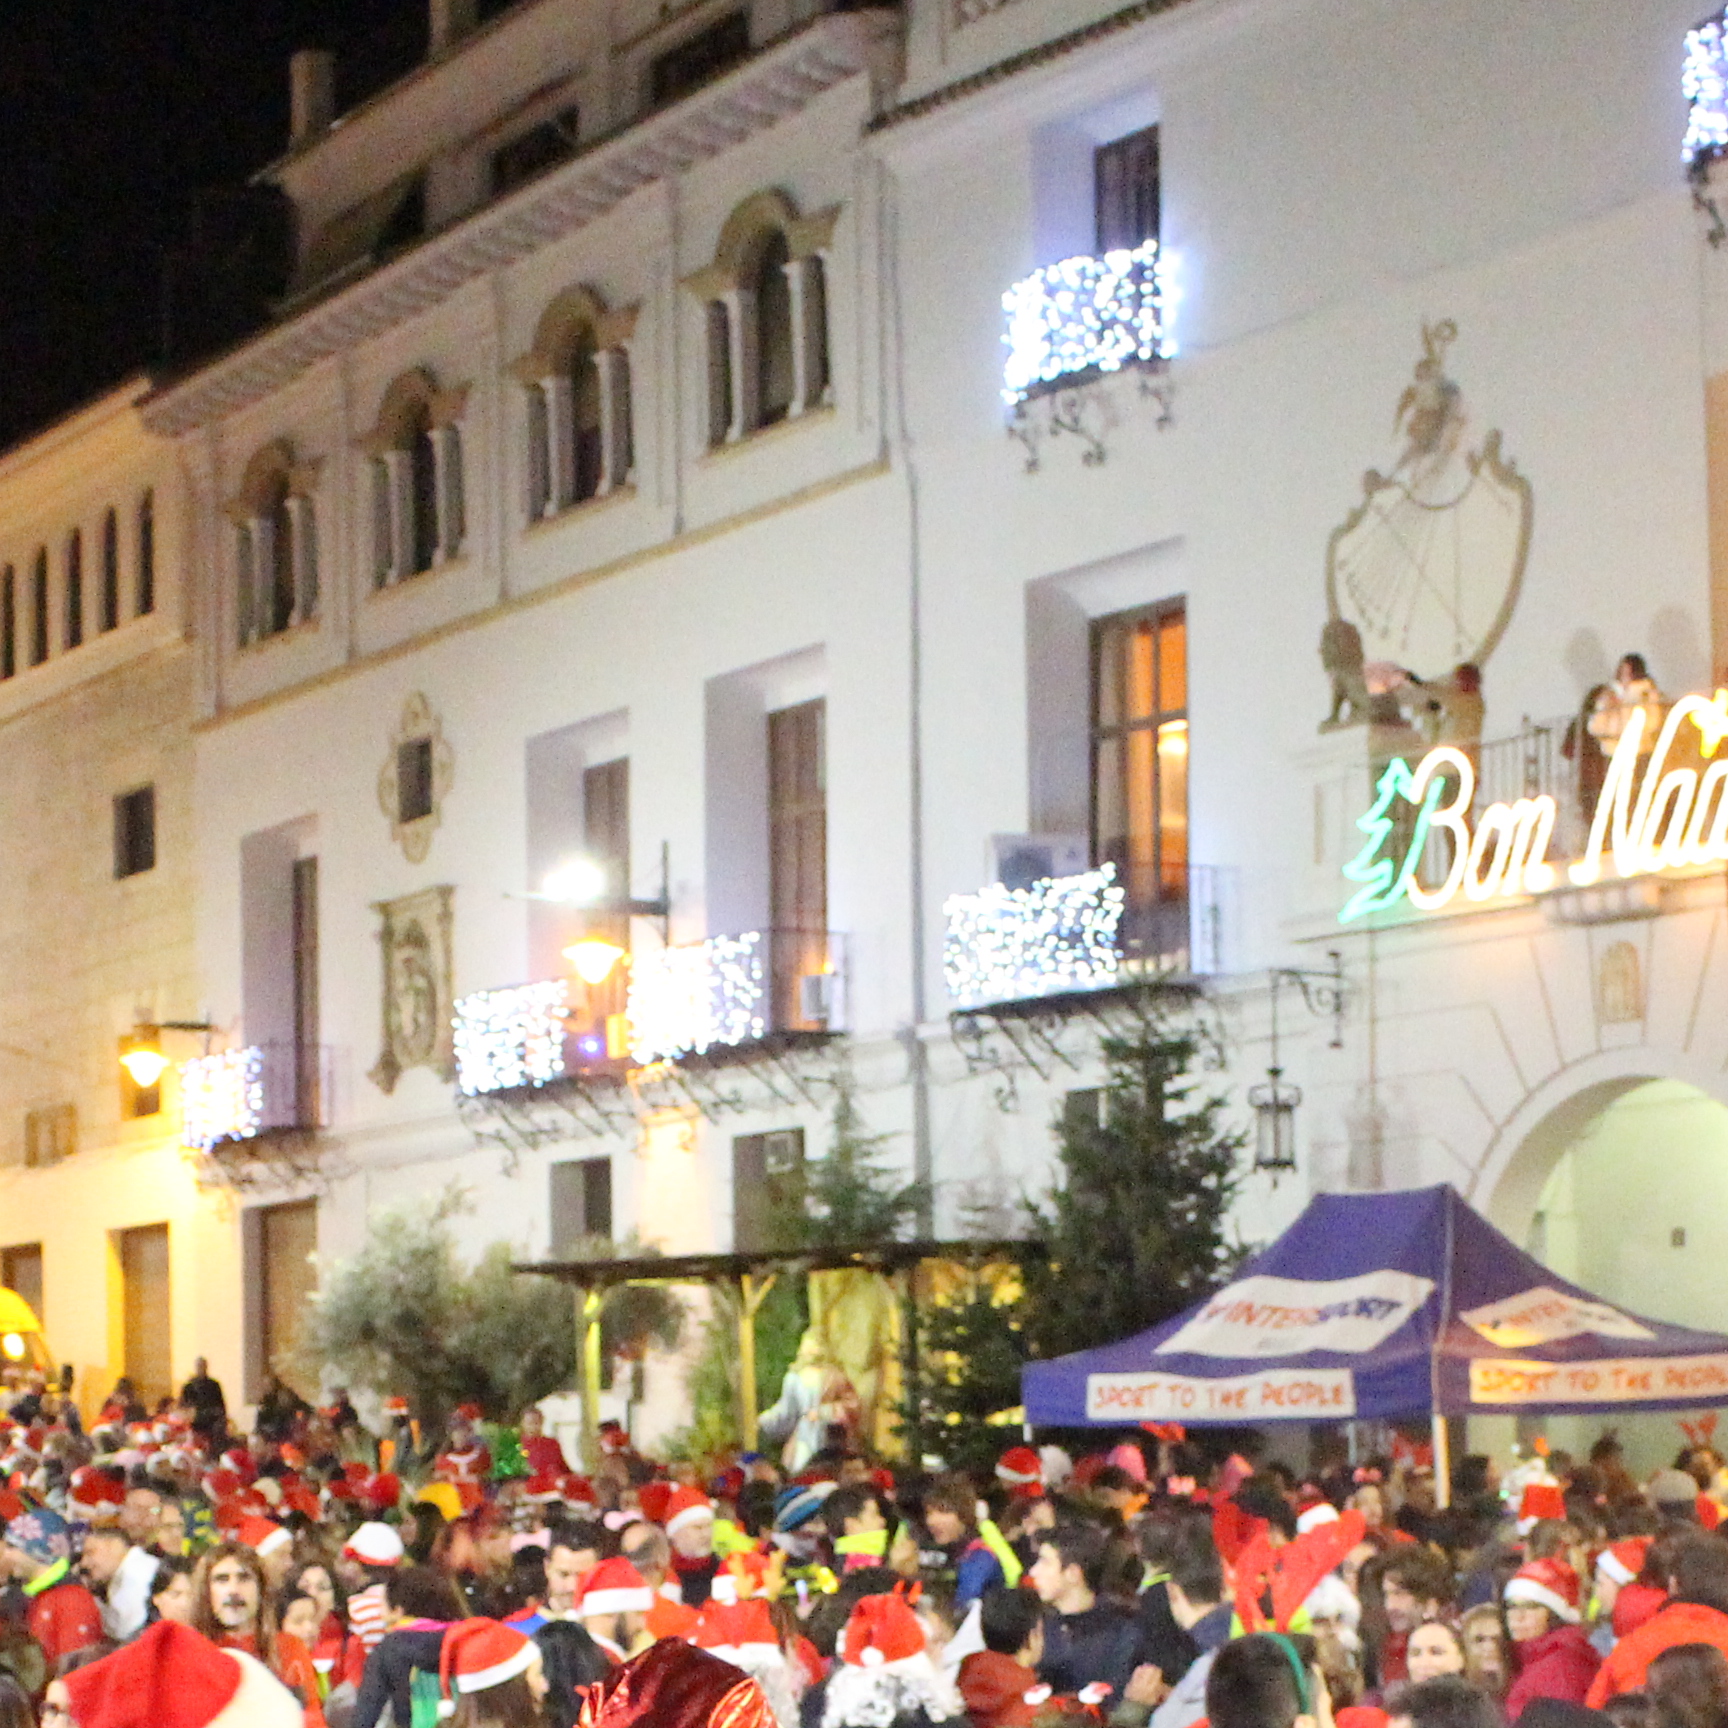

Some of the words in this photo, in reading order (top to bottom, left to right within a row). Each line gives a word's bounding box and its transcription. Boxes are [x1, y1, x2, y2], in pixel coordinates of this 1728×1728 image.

[1405, 745, 1557, 910] Bon
[1479, 1369, 1559, 1393] SPORT
[1565, 1369, 1600, 1392] TO
[1610, 1367, 1652, 1391] THE
[1094, 1383, 1160, 1409] SPORT
[1167, 1383, 1197, 1409] TO
[1207, 1385, 1250, 1409] THE
[1260, 1381, 1344, 1407] PEOPLE
